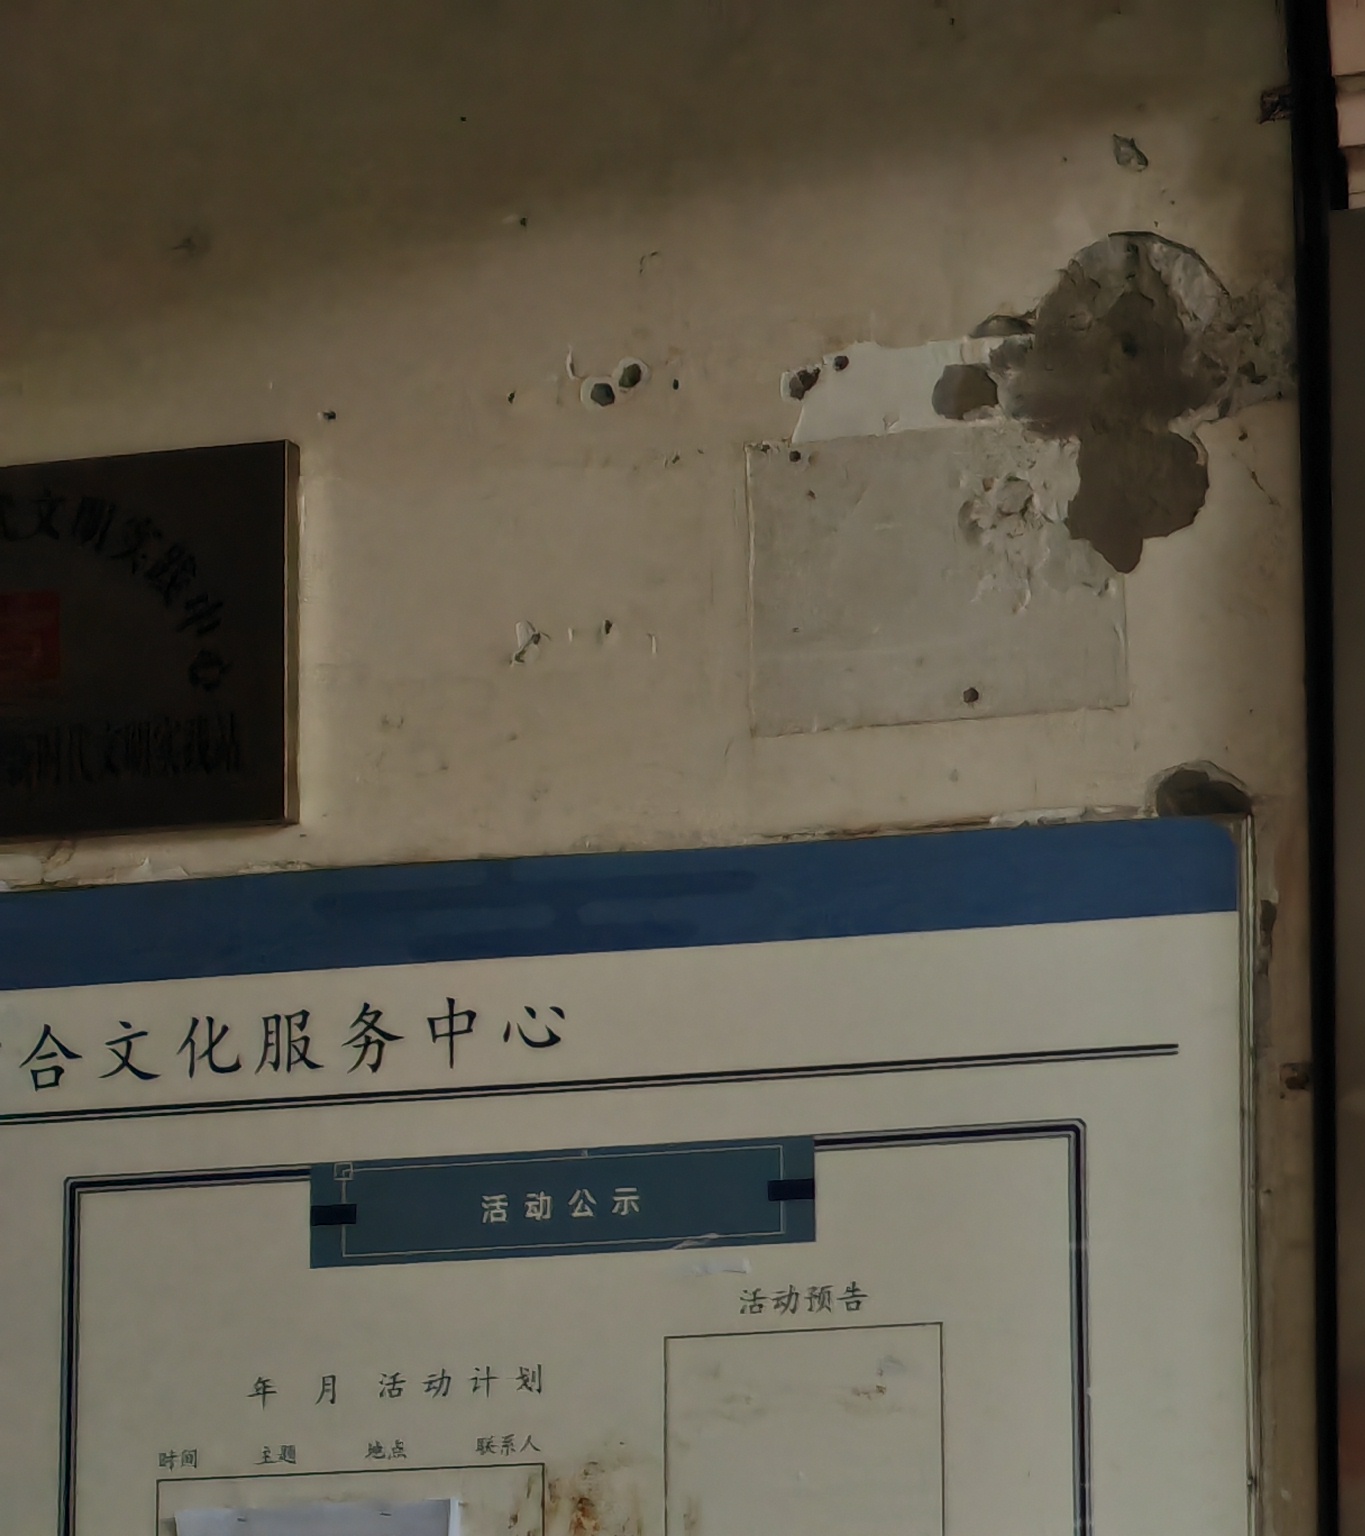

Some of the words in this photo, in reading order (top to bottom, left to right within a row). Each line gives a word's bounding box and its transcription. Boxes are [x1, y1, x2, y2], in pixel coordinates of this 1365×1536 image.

[19, 996, 566, 1092] 合文化服务中心
[481, 1186, 640, 1225] 活动公示
[739, 1281, 868, 1315] 活动预告
[247, 1376, 277, 1408] 年
[314, 1374, 338, 1405] 月
[378, 1364, 543, 1399] 活动计划
[253, 1445, 297, 1465] 主题
[364, 1441, 408, 1460] 地点
[476, 1435, 542, 1456] 联系人
